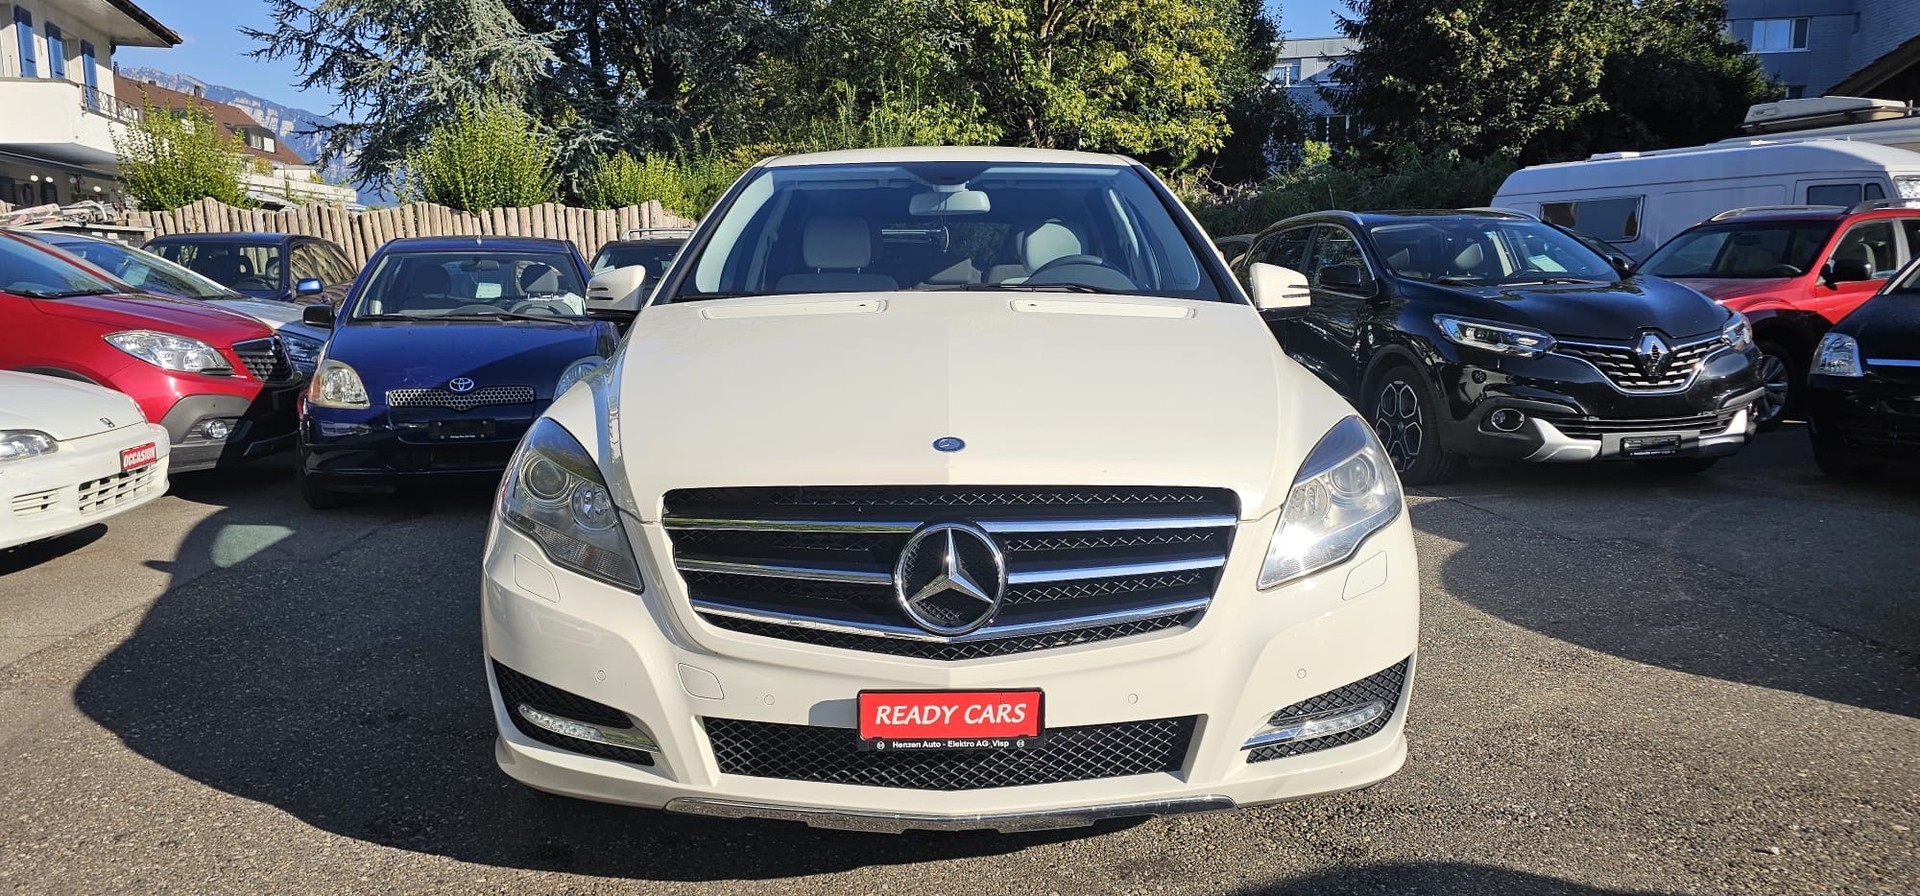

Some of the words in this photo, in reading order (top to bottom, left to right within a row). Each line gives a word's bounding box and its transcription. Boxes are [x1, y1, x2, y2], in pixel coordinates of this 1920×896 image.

[123, 446, 155, 468] OCCASION
[875, 705, 959, 725] READY
[964, 703, 1027, 724] CARS
[922, 740, 941, 748] Auto
[947, 740, 975, 748] Elektro
